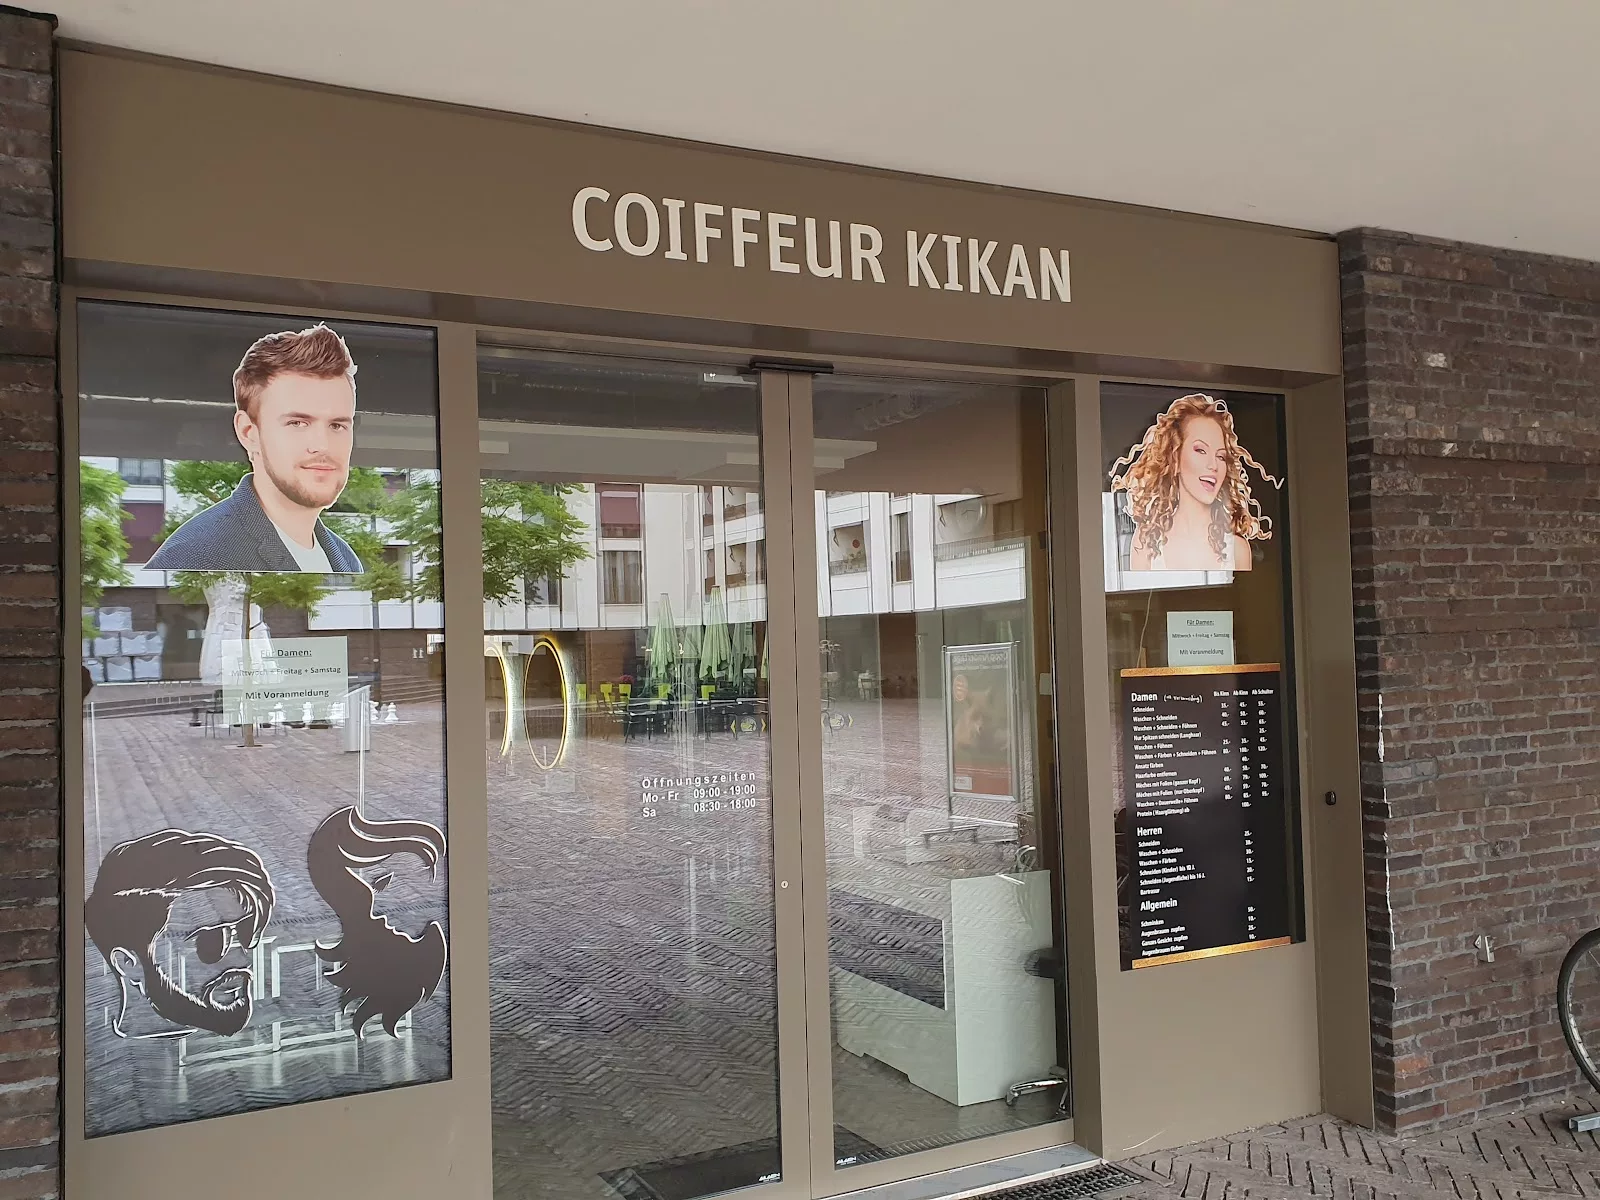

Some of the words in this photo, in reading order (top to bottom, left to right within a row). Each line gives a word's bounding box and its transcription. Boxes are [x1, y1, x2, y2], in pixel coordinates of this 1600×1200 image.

[571, 186, 886, 284] COIFFEUR
[906, 230, 1072, 303] KIKAN
[277, 649, 312, 658] Damen:
[264, 689, 329, 698] Voranmeldung
[1131, 693, 1157, 701] Damen
[642, 772, 755, 788] Öffnungszeiten
[642, 793, 658, 803] Mo
[668, 791, 679, 800] Fr
[694, 787, 720, 798] 09:00
[730, 785, 755, 795] 19:00
[643, 808, 656, 817] Sa
[694, 801, 720, 812] 08:30
[730, 798, 755, 809] 18:00
[1137, 827, 1162, 836] Herren
[1140, 878, 1161, 886] Schneiden
[1140, 898, 1177, 912] Allgemein
